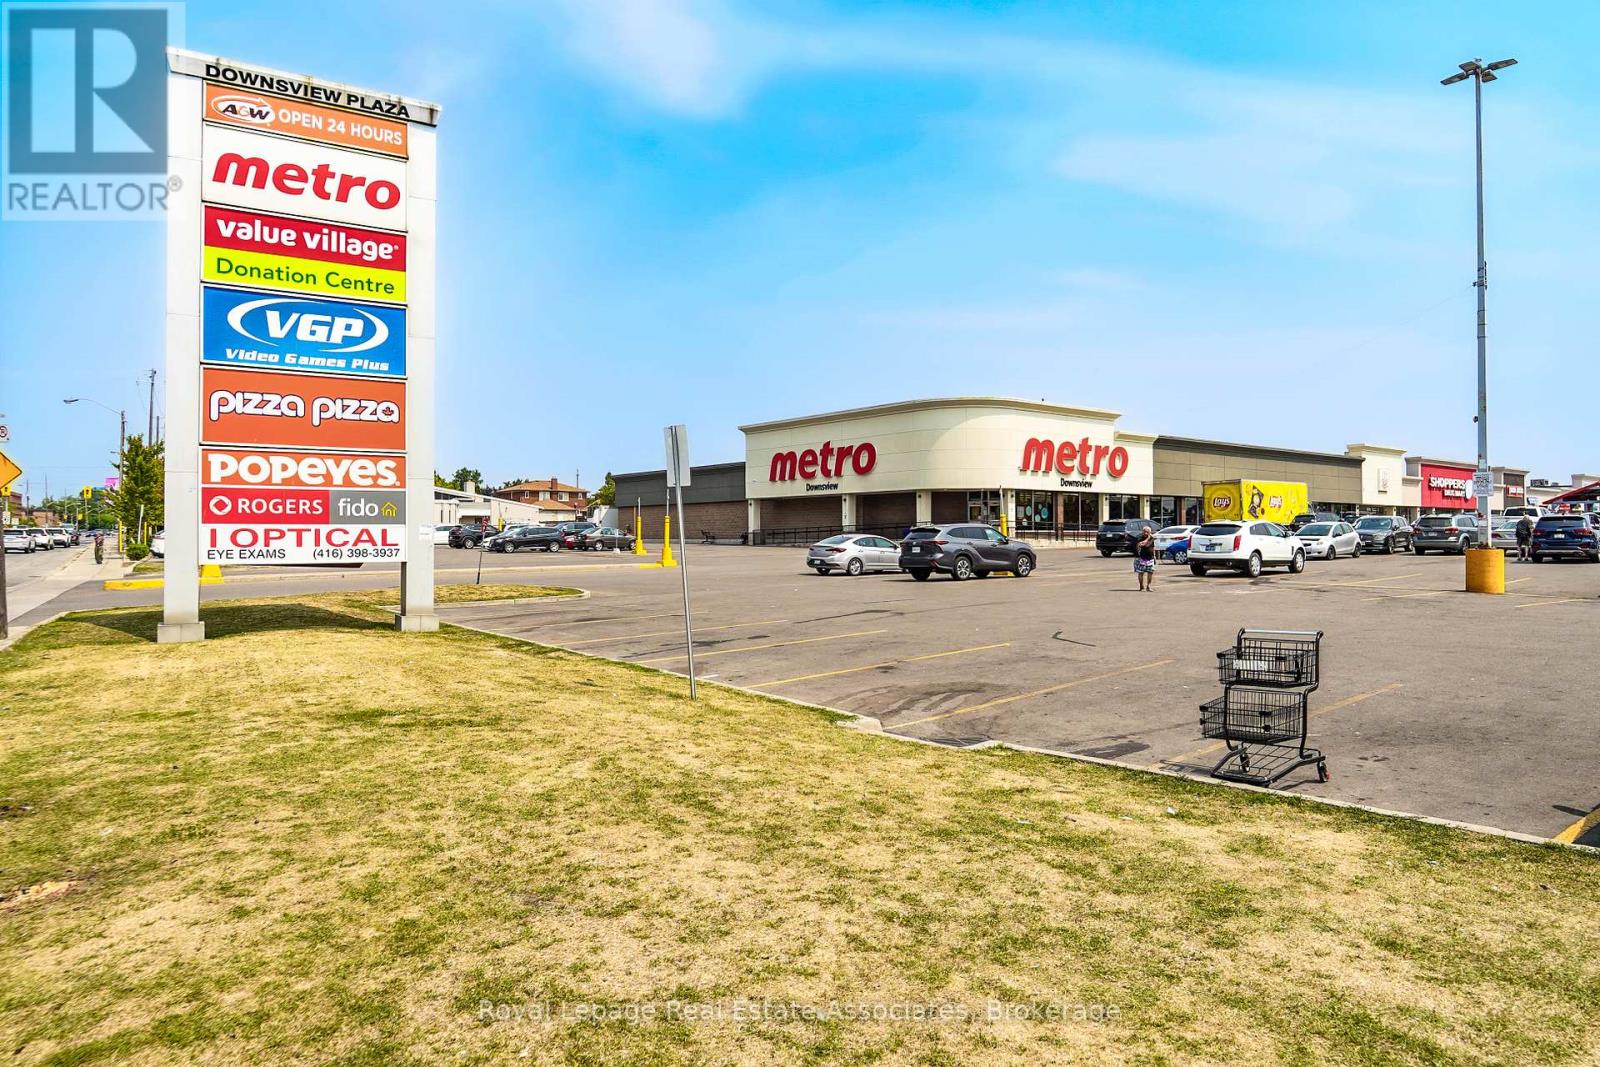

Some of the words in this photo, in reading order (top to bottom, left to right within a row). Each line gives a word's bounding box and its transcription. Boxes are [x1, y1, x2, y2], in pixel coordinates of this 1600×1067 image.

[205, 64, 342, 104] DOWNSVIEW
[346, 93, 410, 119] PLAZA
[222, 104, 270, 121] A&W
[278, 108, 323, 129] OPEN
[327, 119, 346, 134] 24
[351, 123, 402, 146] HOURS
[212, 152, 401, 209] metro
[216, 218, 297, 246] value
[216, 257, 317, 285] Donation
[325, 271, 395, 294] Centre
[265, 309, 365, 345] VGP
[225, 348, 280, 363] Video
[285, 355, 346, 368] Games
[352, 358, 389, 371] Plus
[769, 440, 877, 482] metro
[1021, 437, 1129, 478] metro
[805, 481, 839, 492] Downsview
[1060, 477, 1093, 489] Downsview
[1429, 476, 1466, 490] SHOPPERS
[237, 497, 324, 515] ROGERS
[338, 497, 379, 517] fido
[210, 528, 217, 548] I
[230, 528, 399, 548] OPTICAL
[207, 549, 235, 560] EYE
[239, 549, 287, 560] EXAMS
[312, 548, 344, 561] (416)
[347, 548, 401, 559] 398-3937
